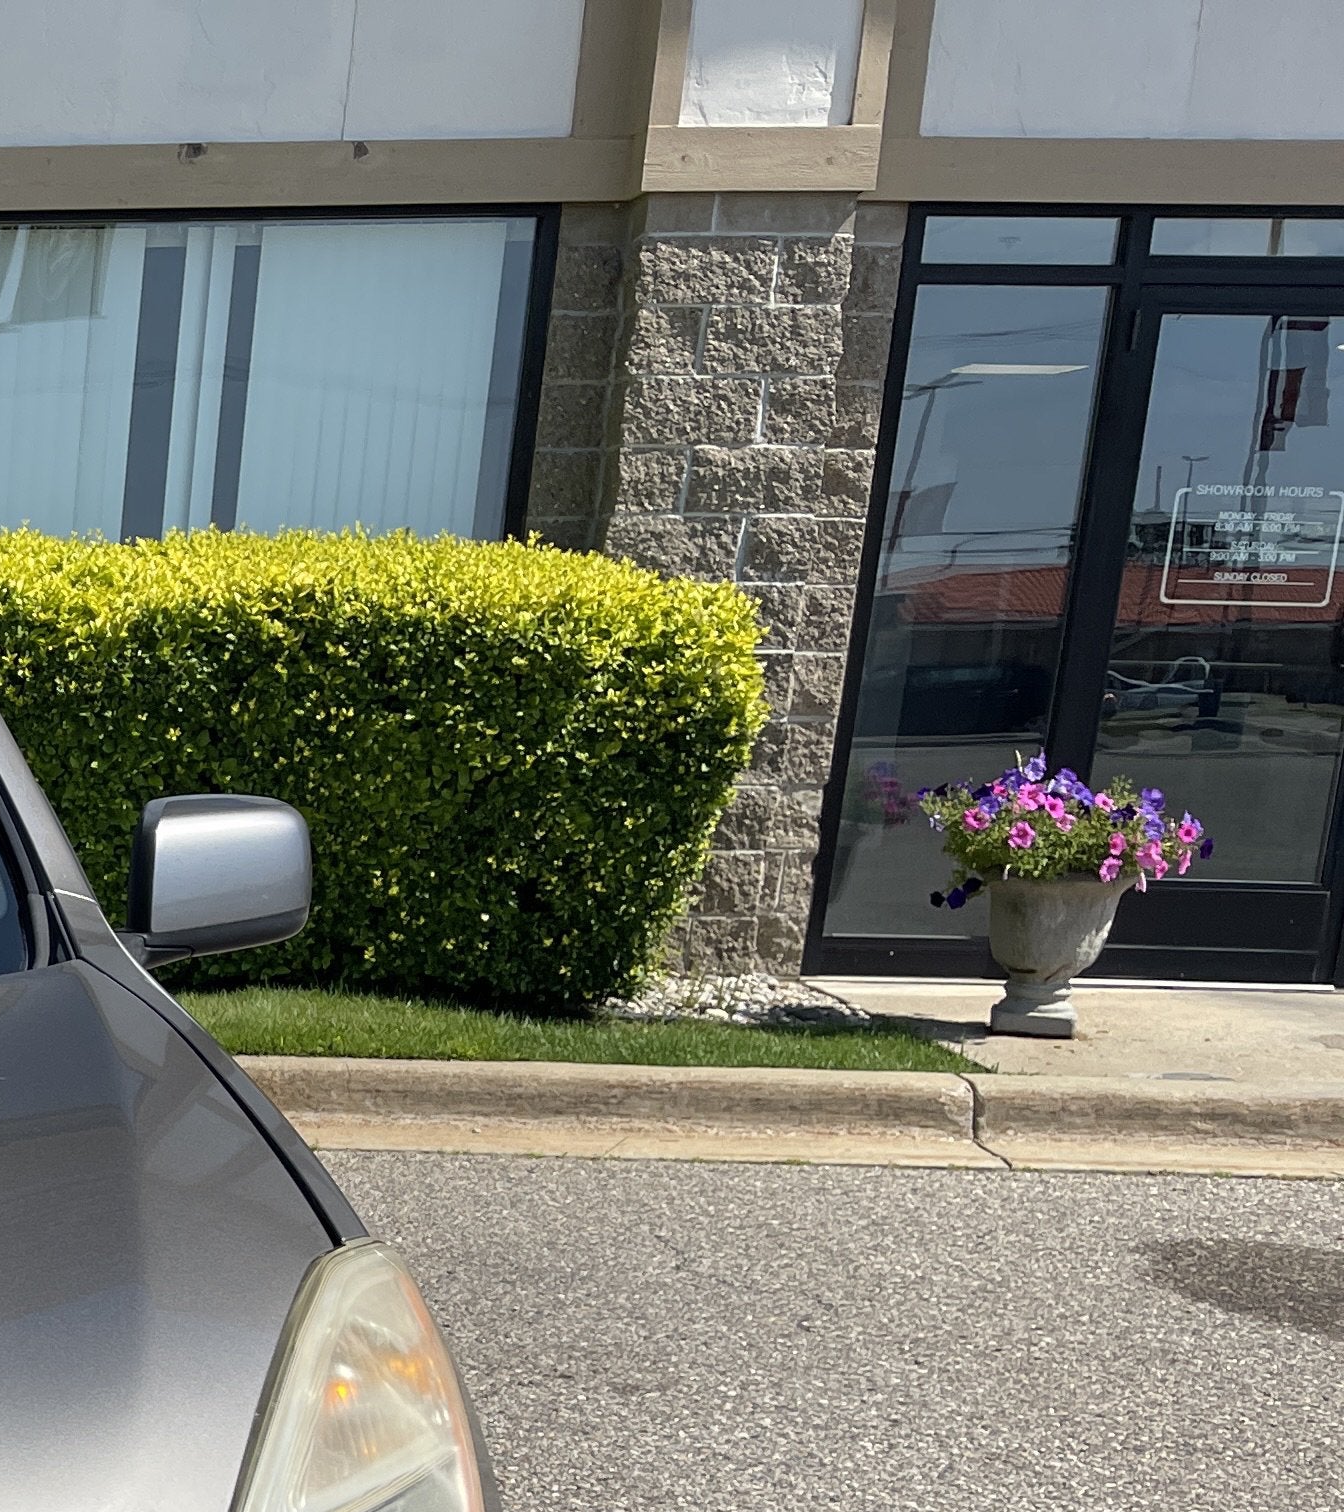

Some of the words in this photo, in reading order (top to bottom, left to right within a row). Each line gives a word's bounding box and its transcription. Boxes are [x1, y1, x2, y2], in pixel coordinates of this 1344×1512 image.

[1196, 484, 1275, 497] SHOWROOM
[1279, 486, 1324, 498] HOURS
[1218, 511, 1257, 521] MONDAY
[1263, 512, 1296, 522] FRIDAY
[1235, 523, 1253, 532] AM
[1231, 541, 1278, 550] SATURDAY
[1232, 552, 1249, 561] AM
[1279, 553, 1296, 562] PM
[1214, 572, 1249, 581] SUNDAY
[1250, 572, 1288, 583] CLOSED
